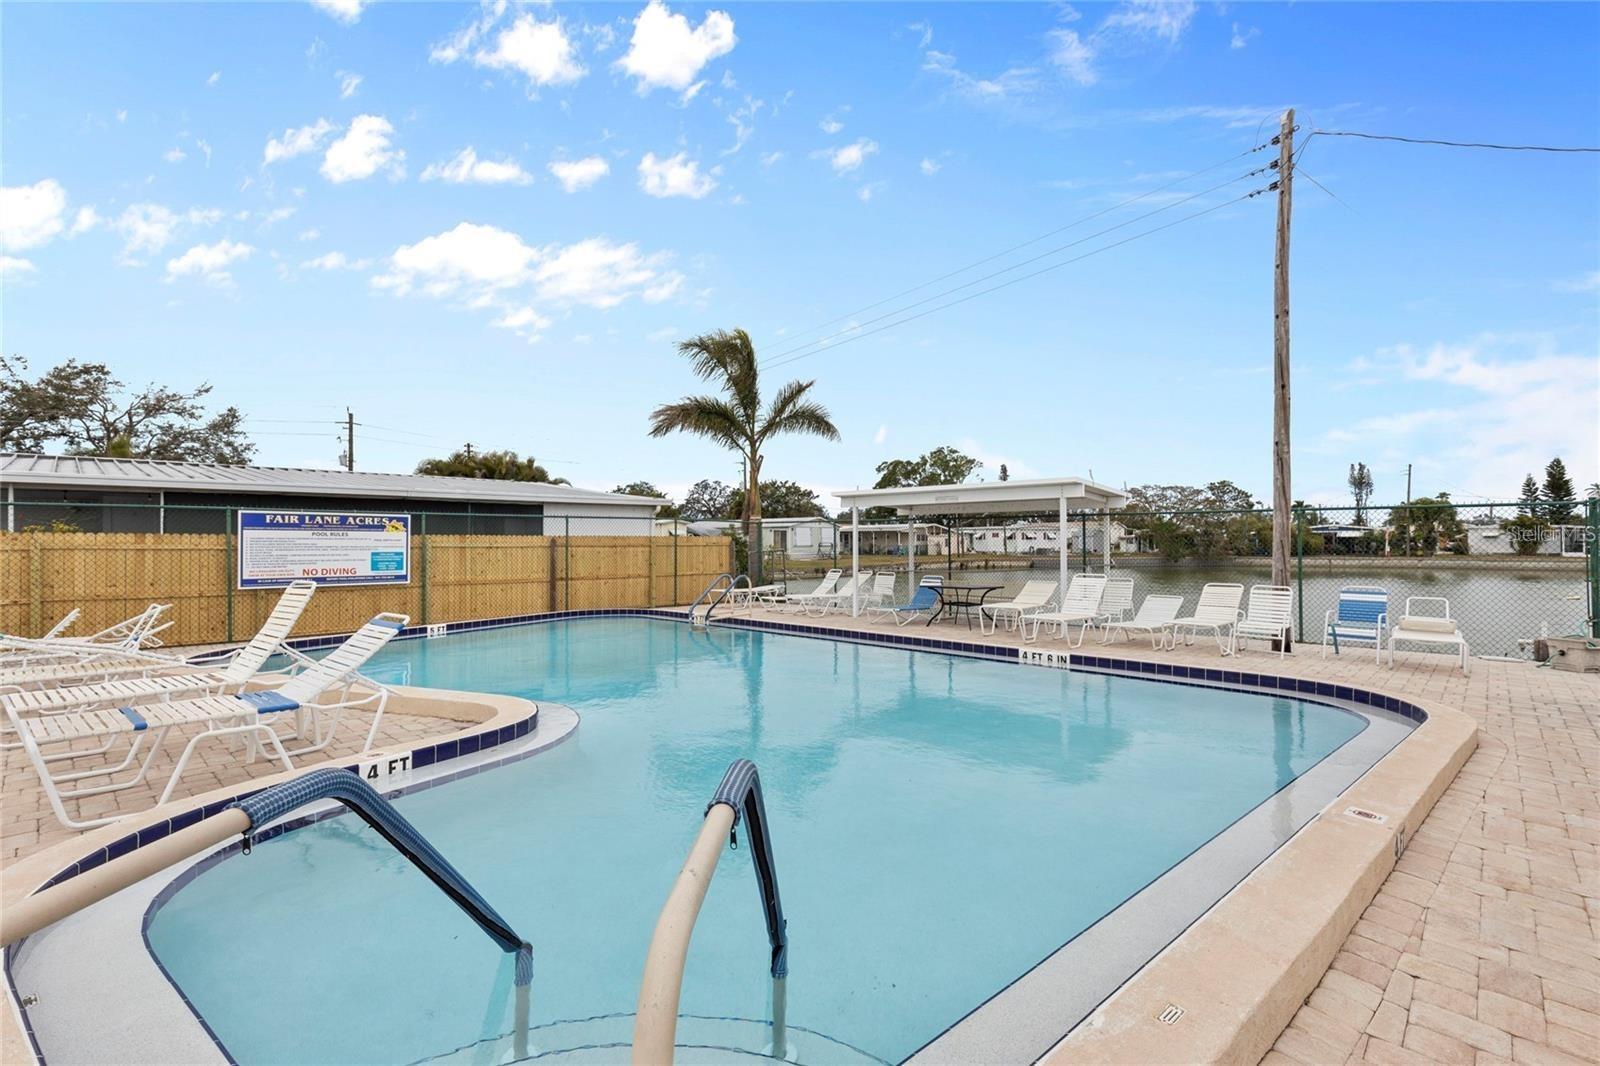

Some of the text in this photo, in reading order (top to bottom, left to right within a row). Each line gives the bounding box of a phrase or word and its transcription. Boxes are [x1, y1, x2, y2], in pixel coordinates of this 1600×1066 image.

[265, 514, 390, 526] FAIR LANE ACRES
[302, 568, 318, 576] NO
[321, 567, 357, 576] DIVING
[1022, 651, 1028, 659] 4
[1032, 652, 1042, 661] FT
[1057, 655, 1067, 664] IN
[367, 756, 410, 779] 4 FT
